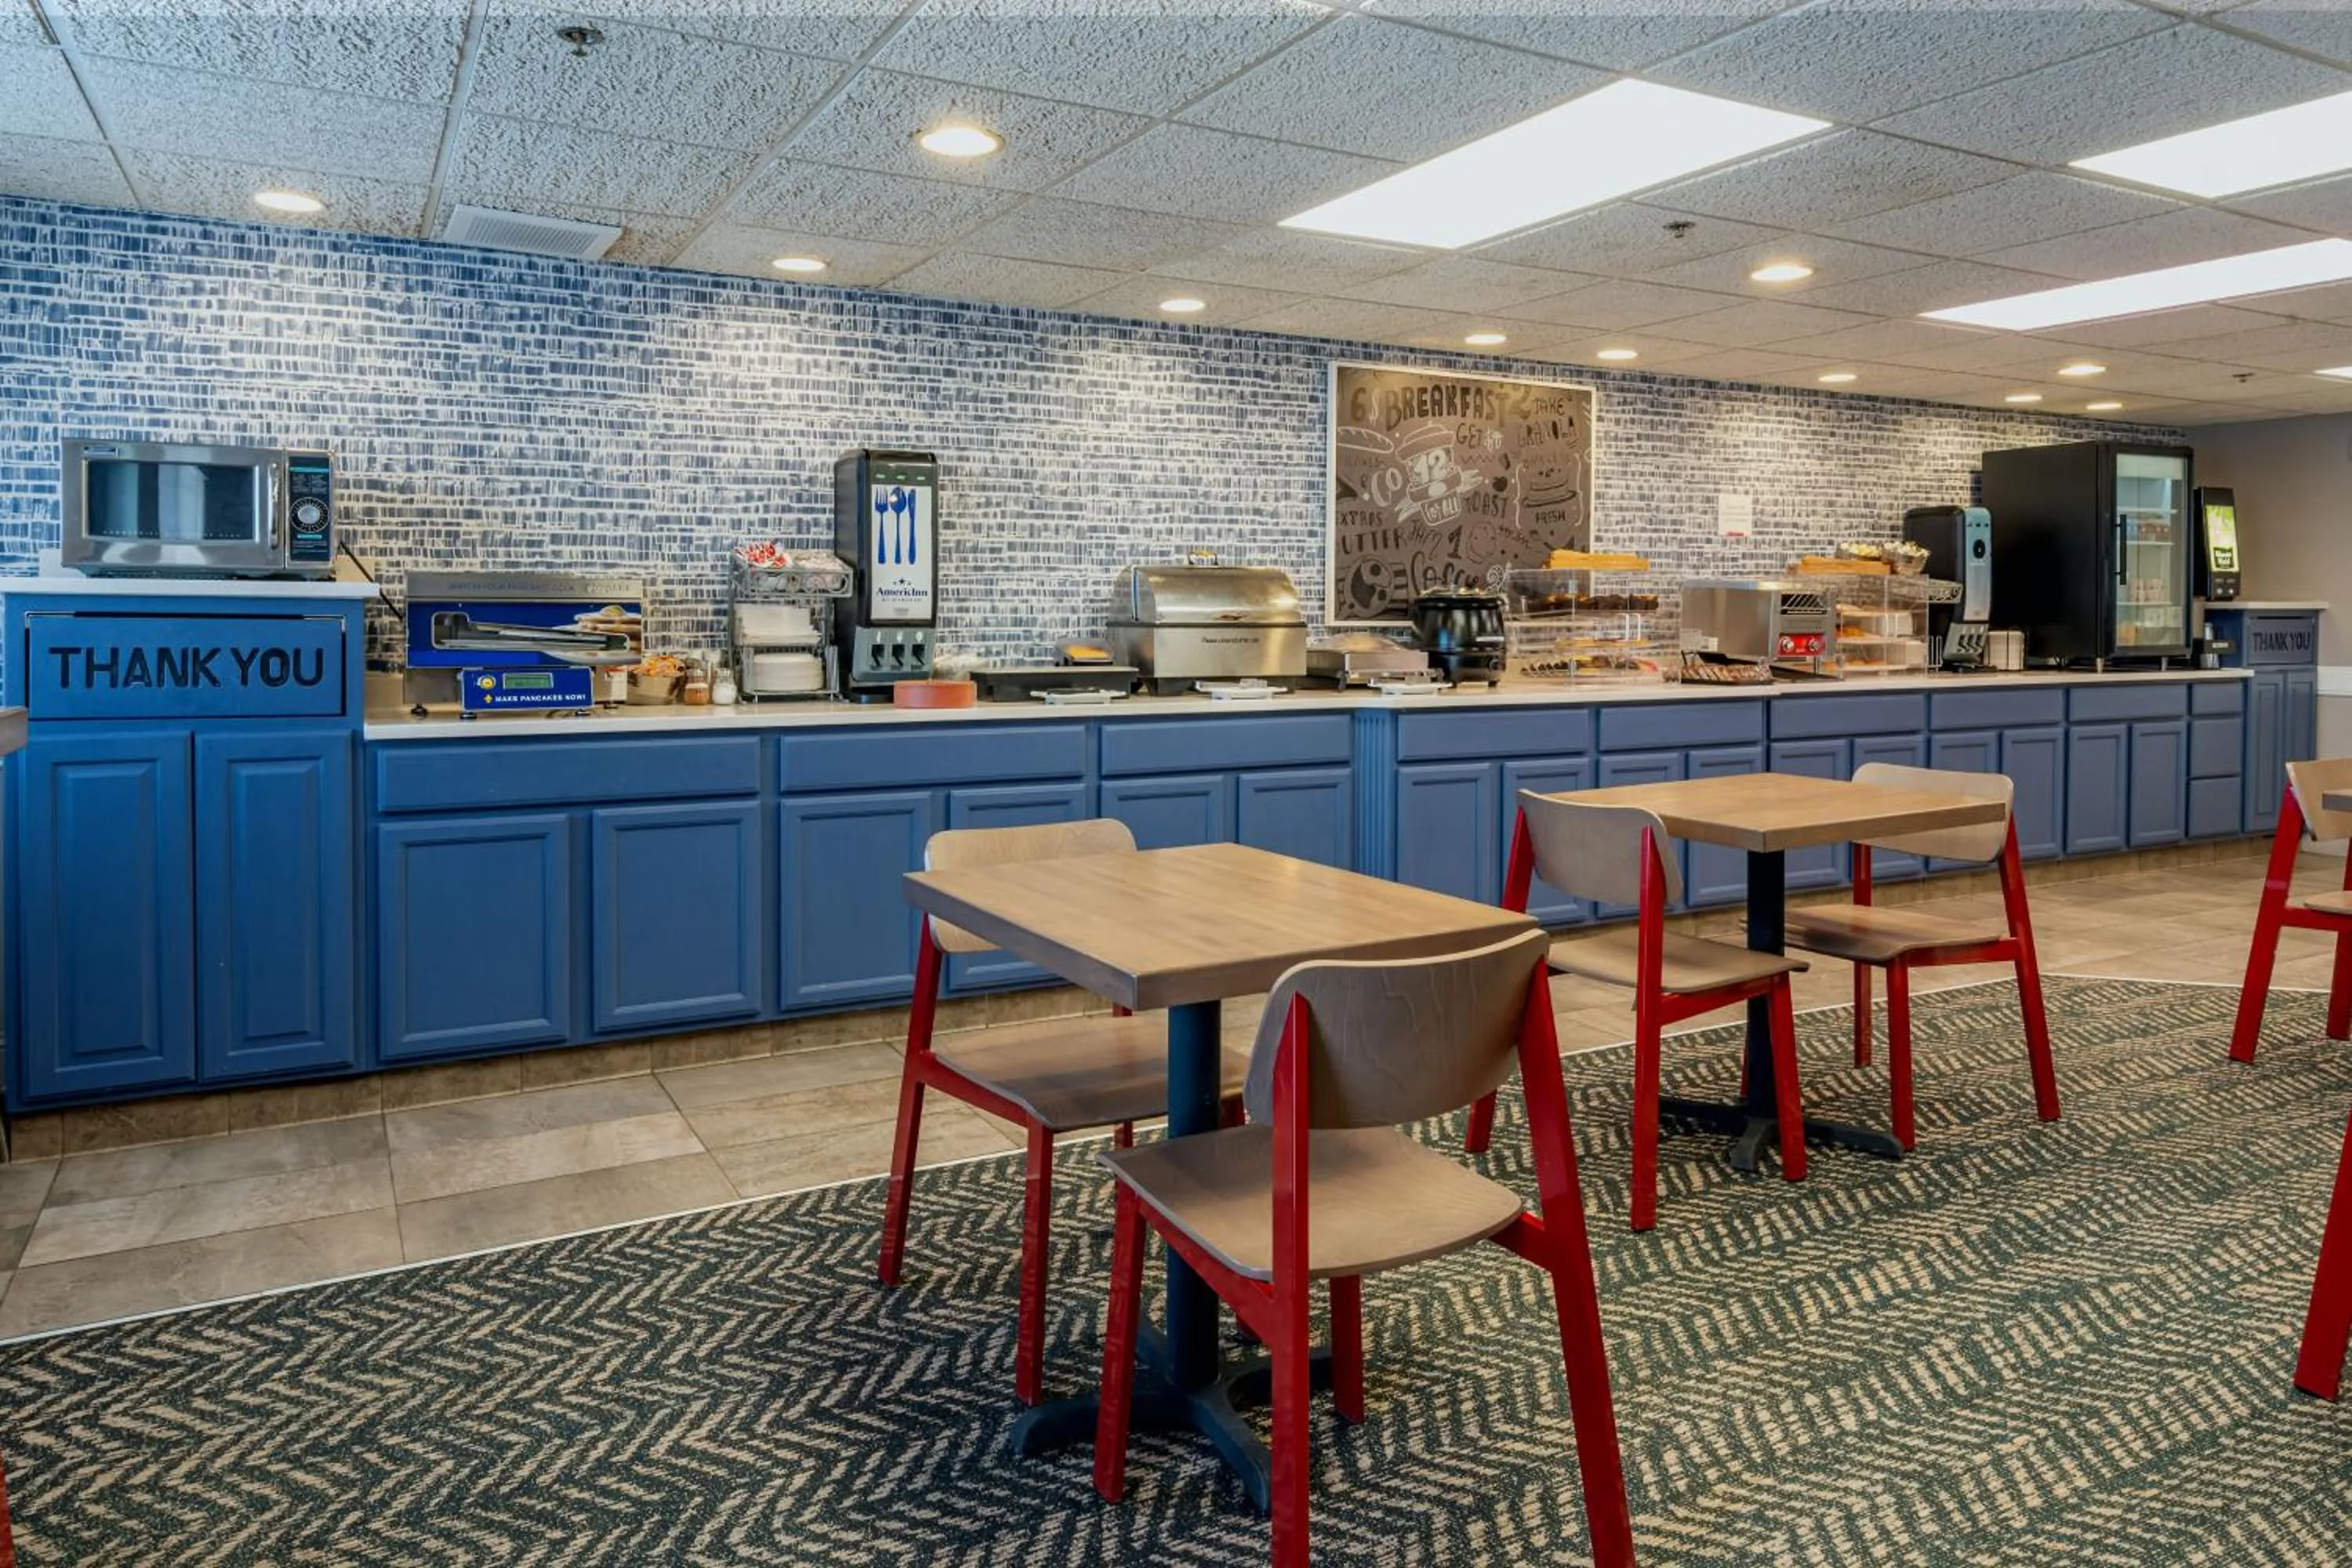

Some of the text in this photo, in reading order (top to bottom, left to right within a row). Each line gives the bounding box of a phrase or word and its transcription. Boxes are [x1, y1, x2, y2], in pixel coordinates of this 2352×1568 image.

[1385, 384, 1510, 431] BREAKFAST
[1464, 492, 1508, 518] TOAST
[877, 587, 927, 596] AmericInn
[2252, 631, 2310, 652] THANK YOU
[49, 647, 324, 688] THANK YOU
